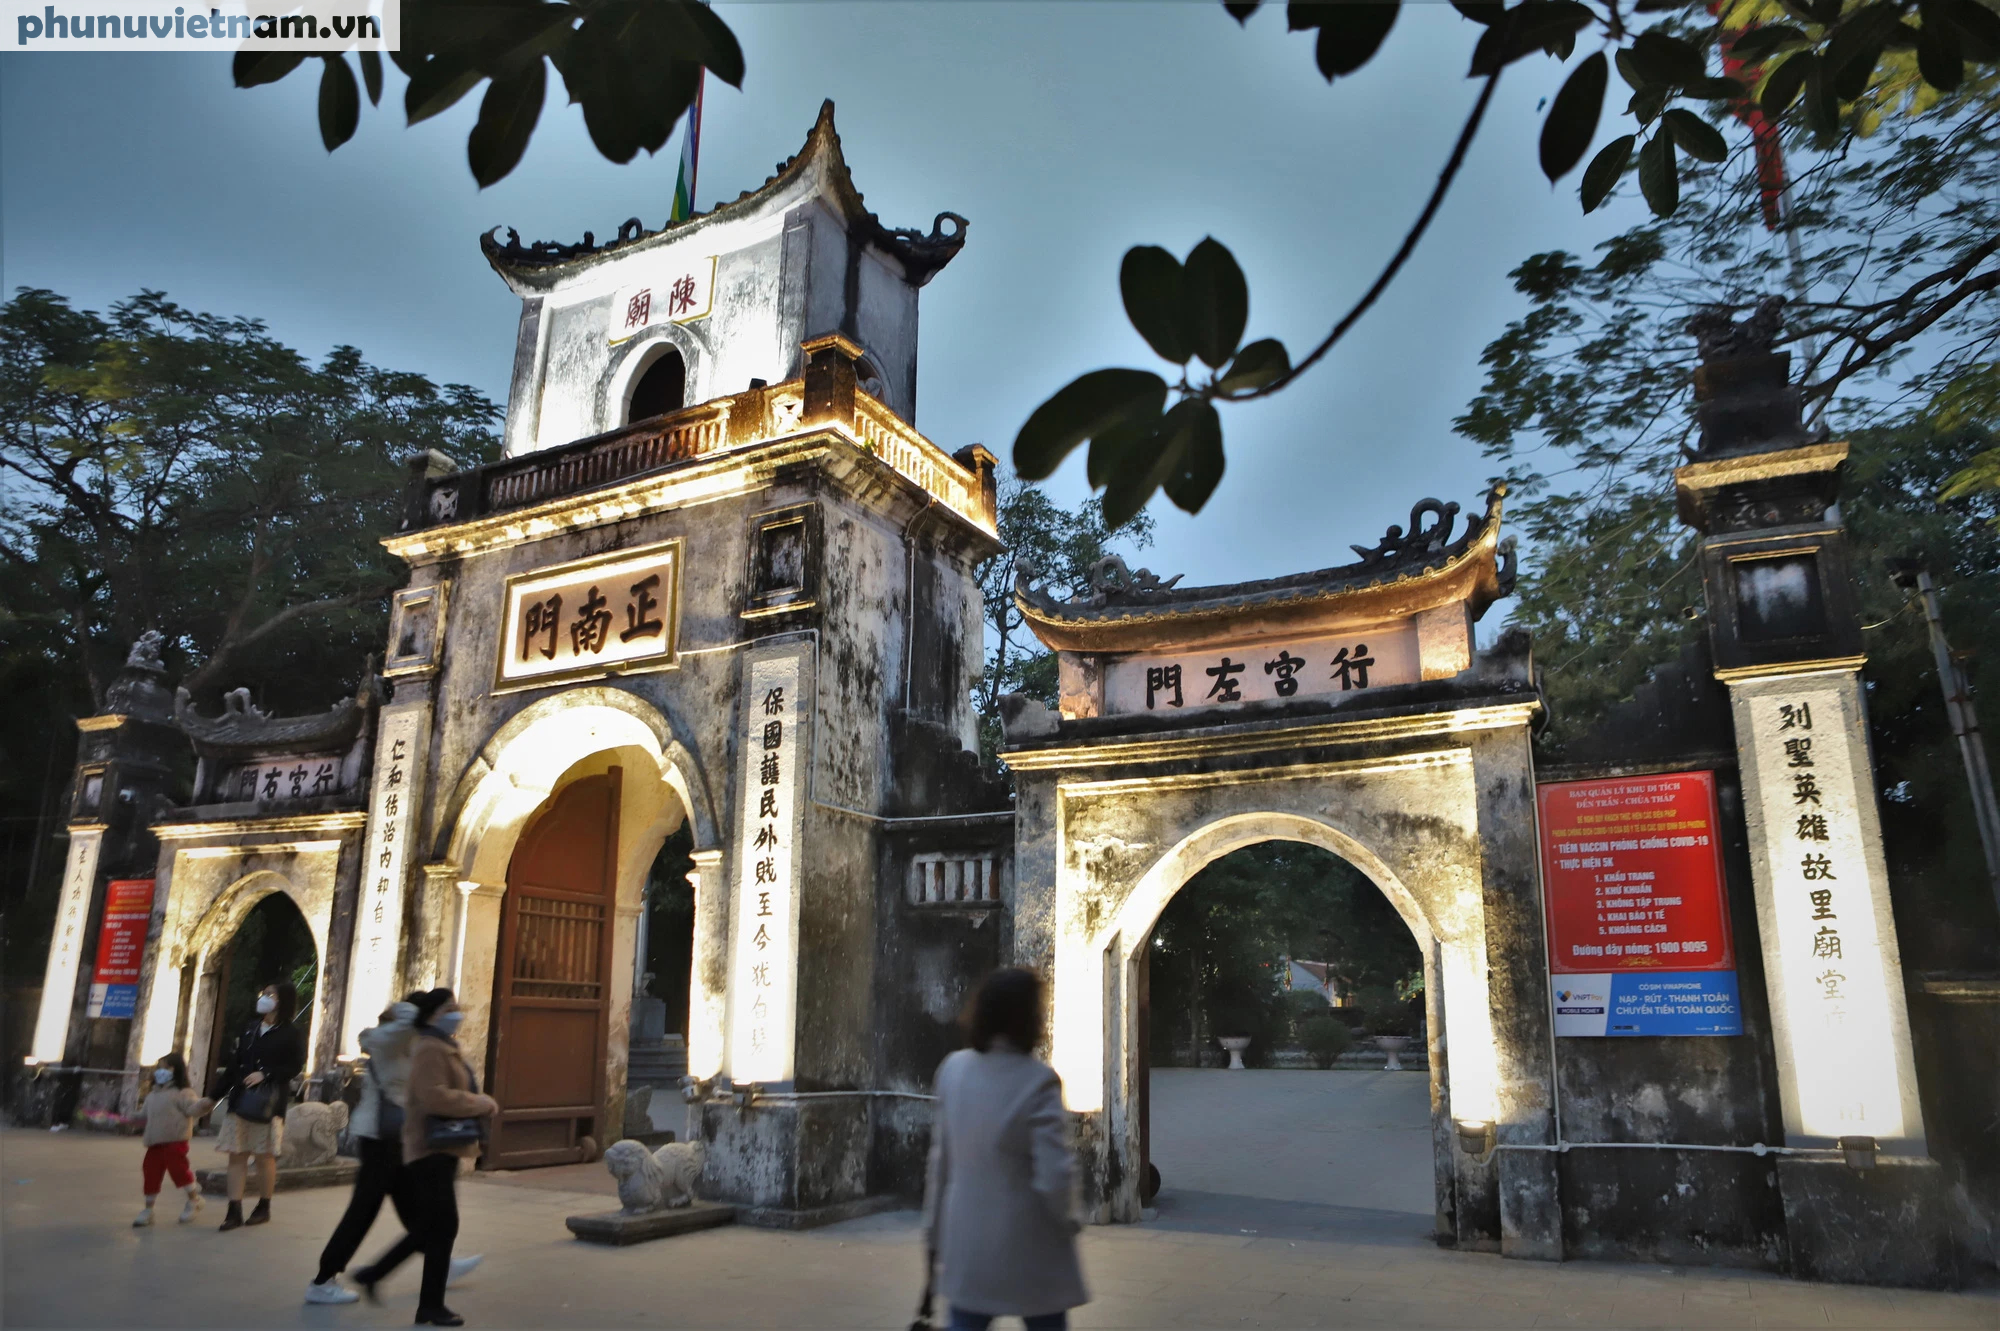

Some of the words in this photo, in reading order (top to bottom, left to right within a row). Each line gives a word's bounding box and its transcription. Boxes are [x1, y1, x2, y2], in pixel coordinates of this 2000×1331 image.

[1569, 790, 1586, 798] BAN
[1627, 785, 1645, 794] KHU
[1647, 784, 1657, 792] DI
[1659, 782, 1681, 791] TÍCH
[1580, 842, 1608, 853] VACCIN
[1670, 836, 1709, 848] COVID-19
[1603, 857, 1614, 867] 5K
[1595, 874, 1602, 882] 1.
[1628, 872, 1655, 881] TRANG
[1596, 888, 1603, 896] 2.
[1596, 901, 1604, 909] 3.
[1654, 897, 1682, 906] TRUNG
[1608, 912, 1627, 921] KHAI
[1629, 910, 1646, 920] BÁO
[1648, 911, 1653, 920] Y
[1654, 909, 1665, 920] TẾ
[1599, 927, 1606, 935] 5.
[1644, 923, 1667, 933] CÁCH
[1625, 942, 1653, 955] nóng:
[1655, 942, 1679, 953] 1900
[1682, 941, 1707, 953] 9095
[1645, 993, 1662, 1003] RÚT
[1668, 994, 1700, 1003] THANH
